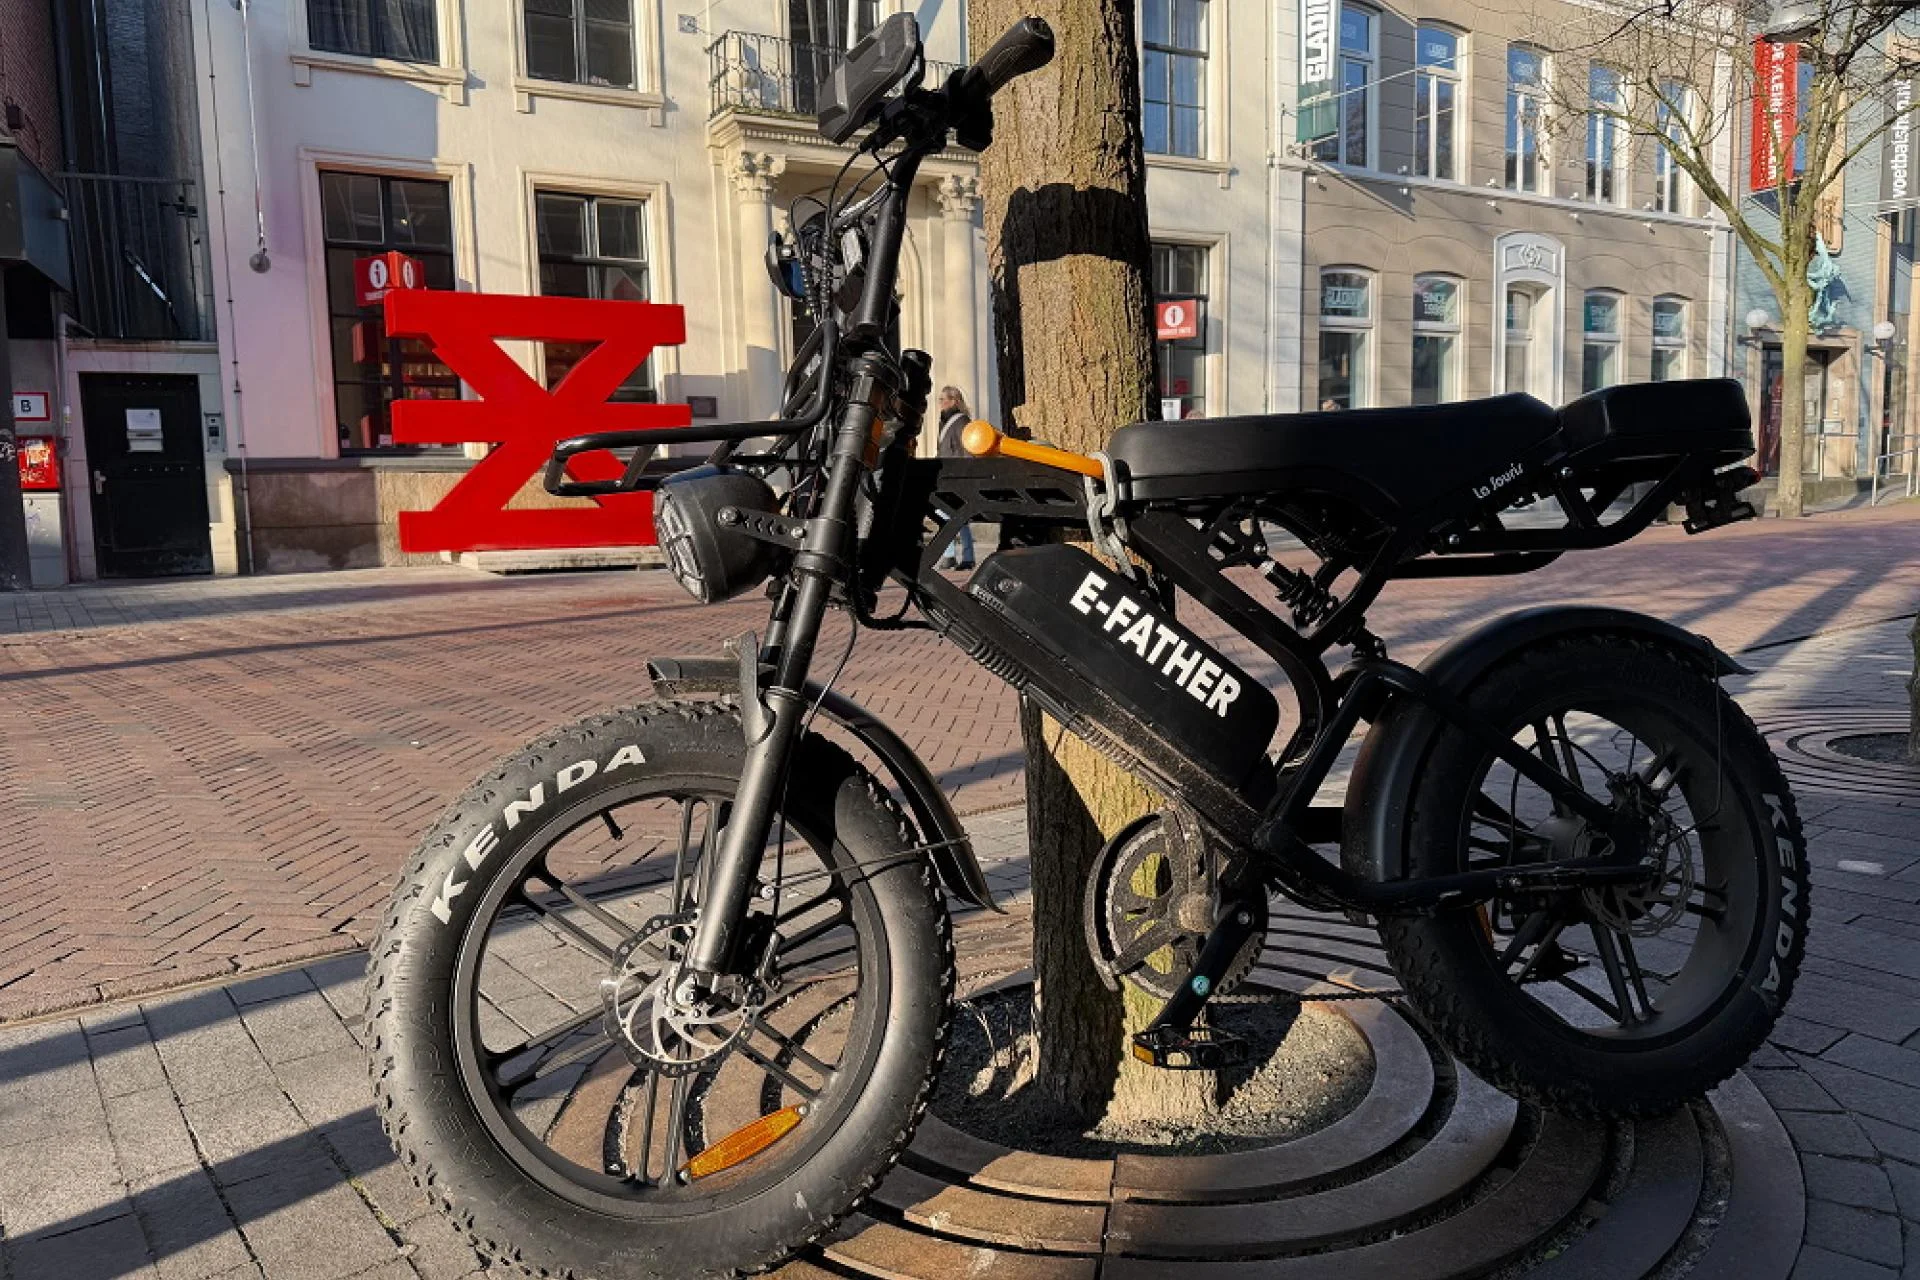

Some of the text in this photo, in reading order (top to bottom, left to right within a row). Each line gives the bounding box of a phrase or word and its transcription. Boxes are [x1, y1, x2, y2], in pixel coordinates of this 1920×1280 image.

[1306, 0, 1328, 81] GLADI
[21, 400, 31, 412] B
[1069, 571, 1241, 717] E-FATHER
[431, 744, 646, 925] KENDA
[1761, 793, 1798, 992] KENDA
